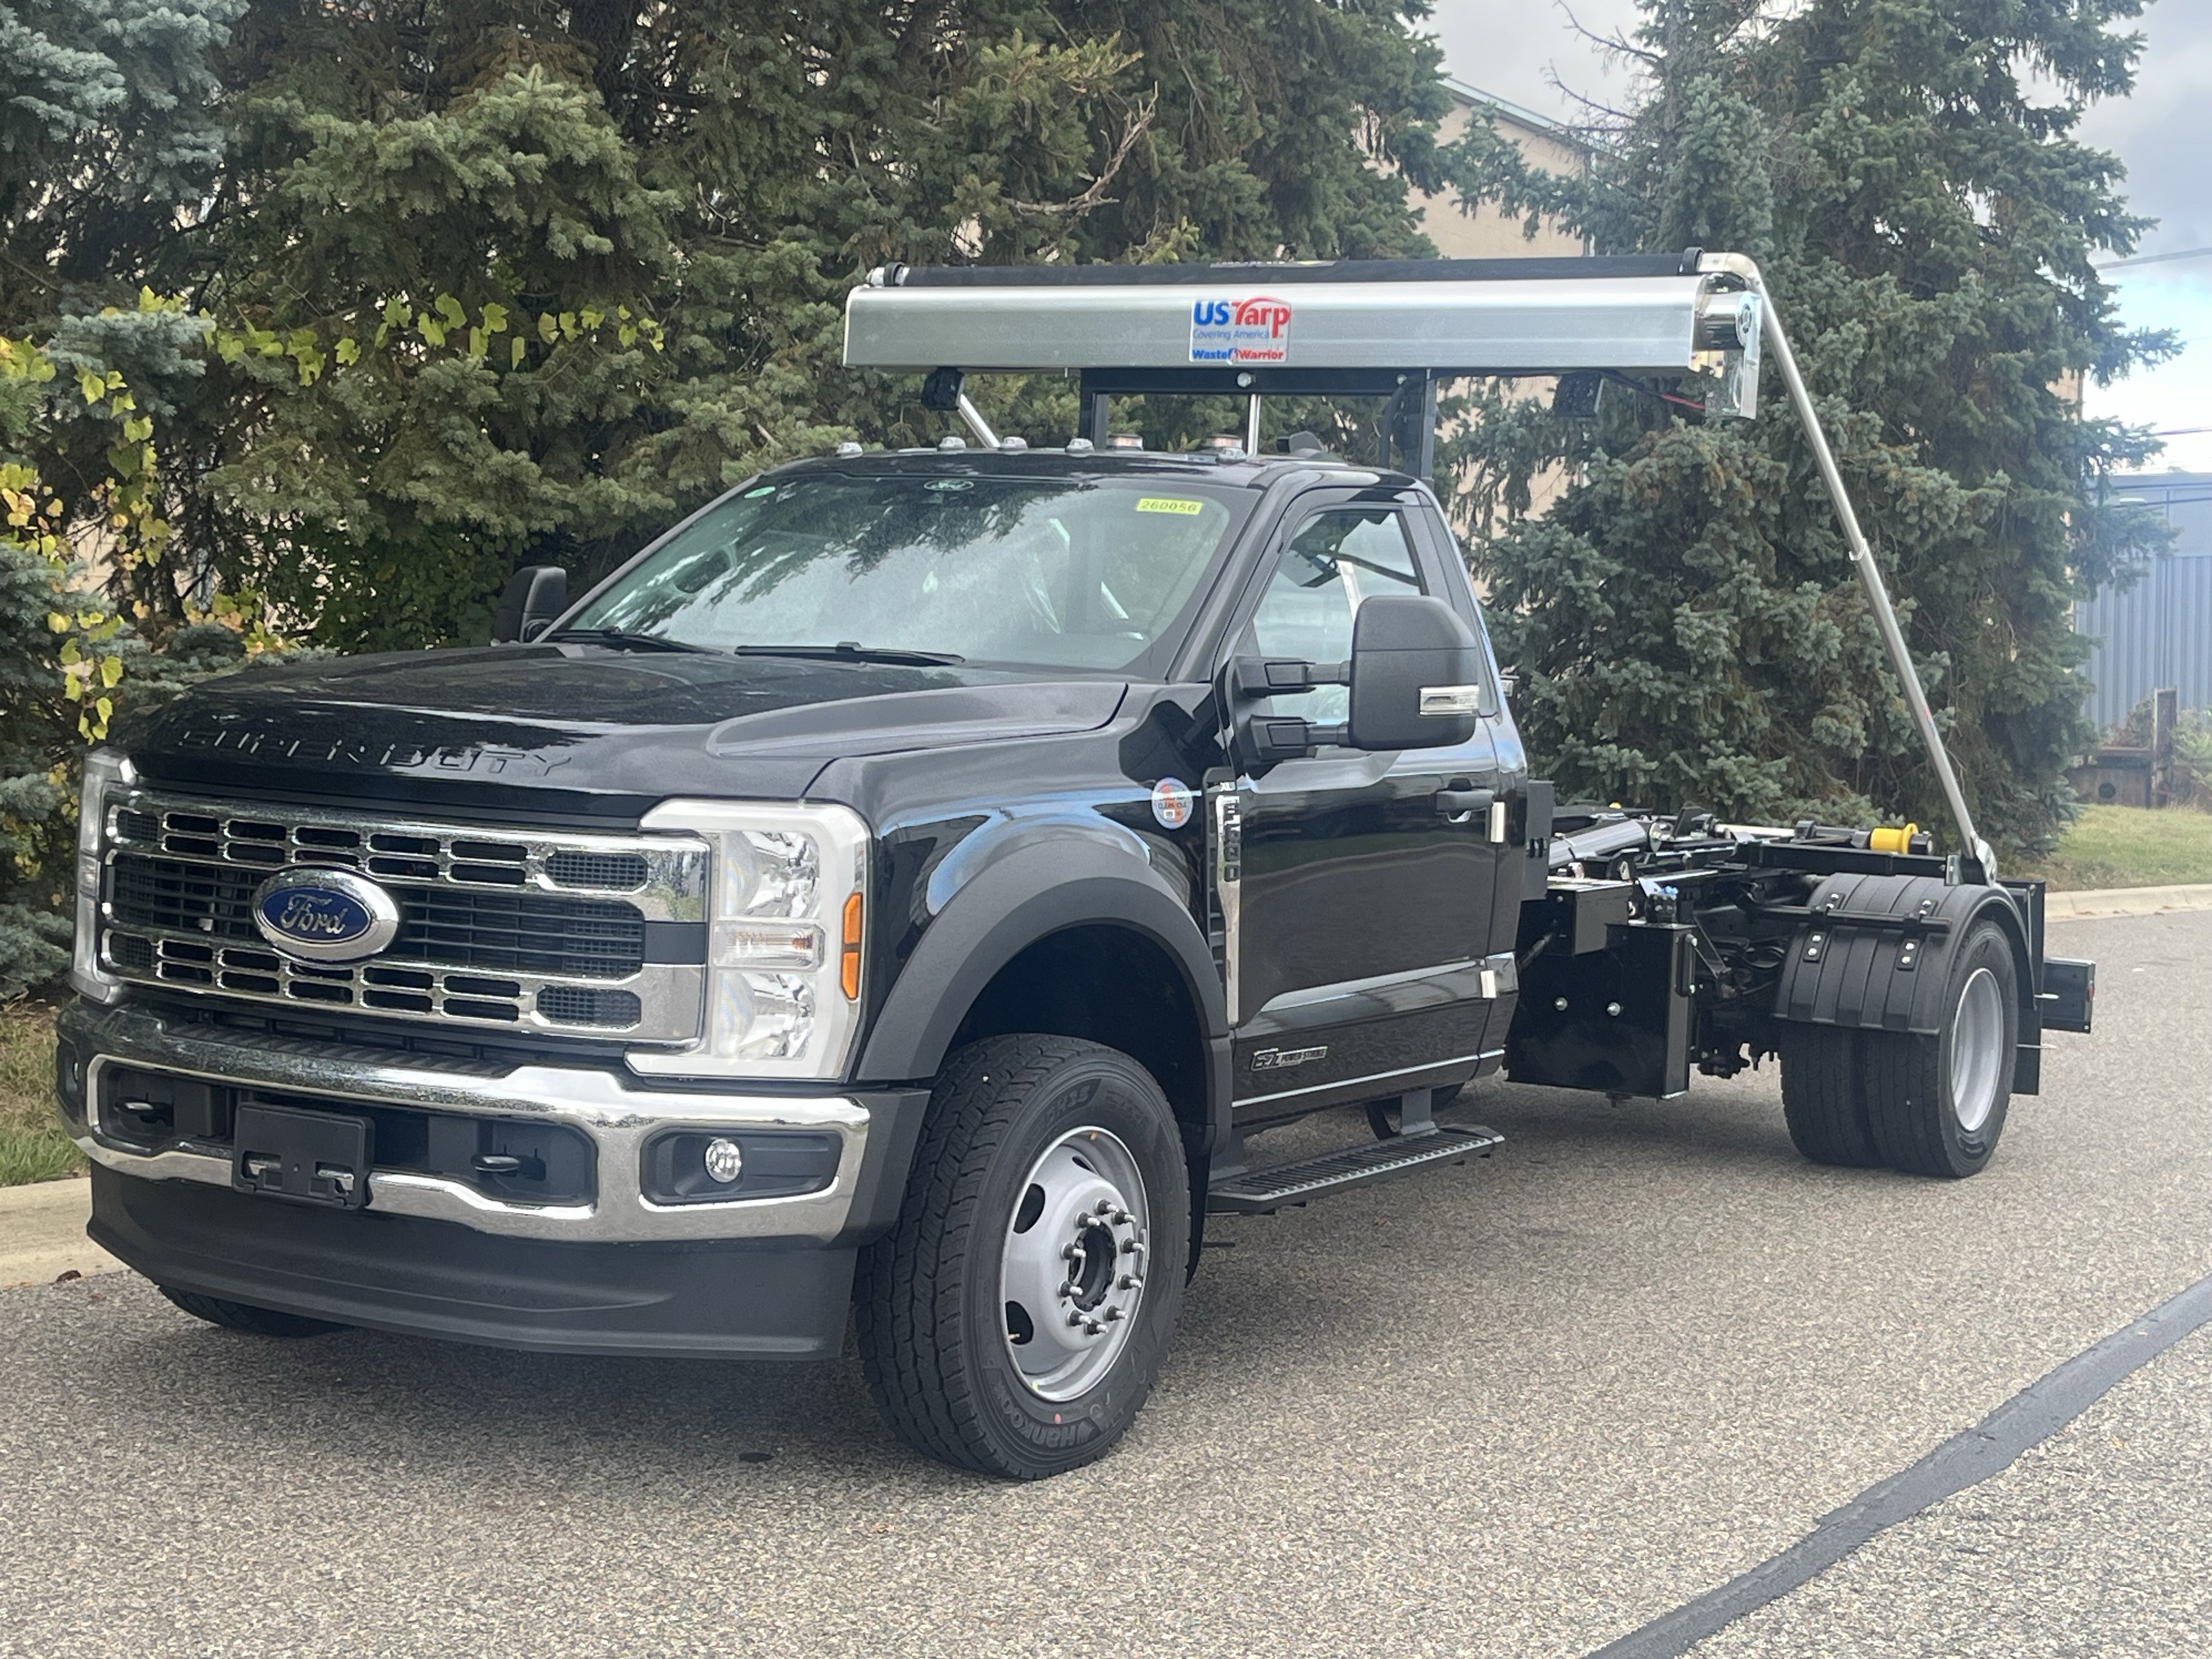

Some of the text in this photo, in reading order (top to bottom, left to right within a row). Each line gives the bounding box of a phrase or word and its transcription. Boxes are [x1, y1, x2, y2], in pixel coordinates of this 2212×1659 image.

[1193, 330, 1231, 341] Covering
[1234, 330, 1269, 339] America
[1239, 349, 1284, 360] Warrior
[280, 893, 349, 935] Ford
